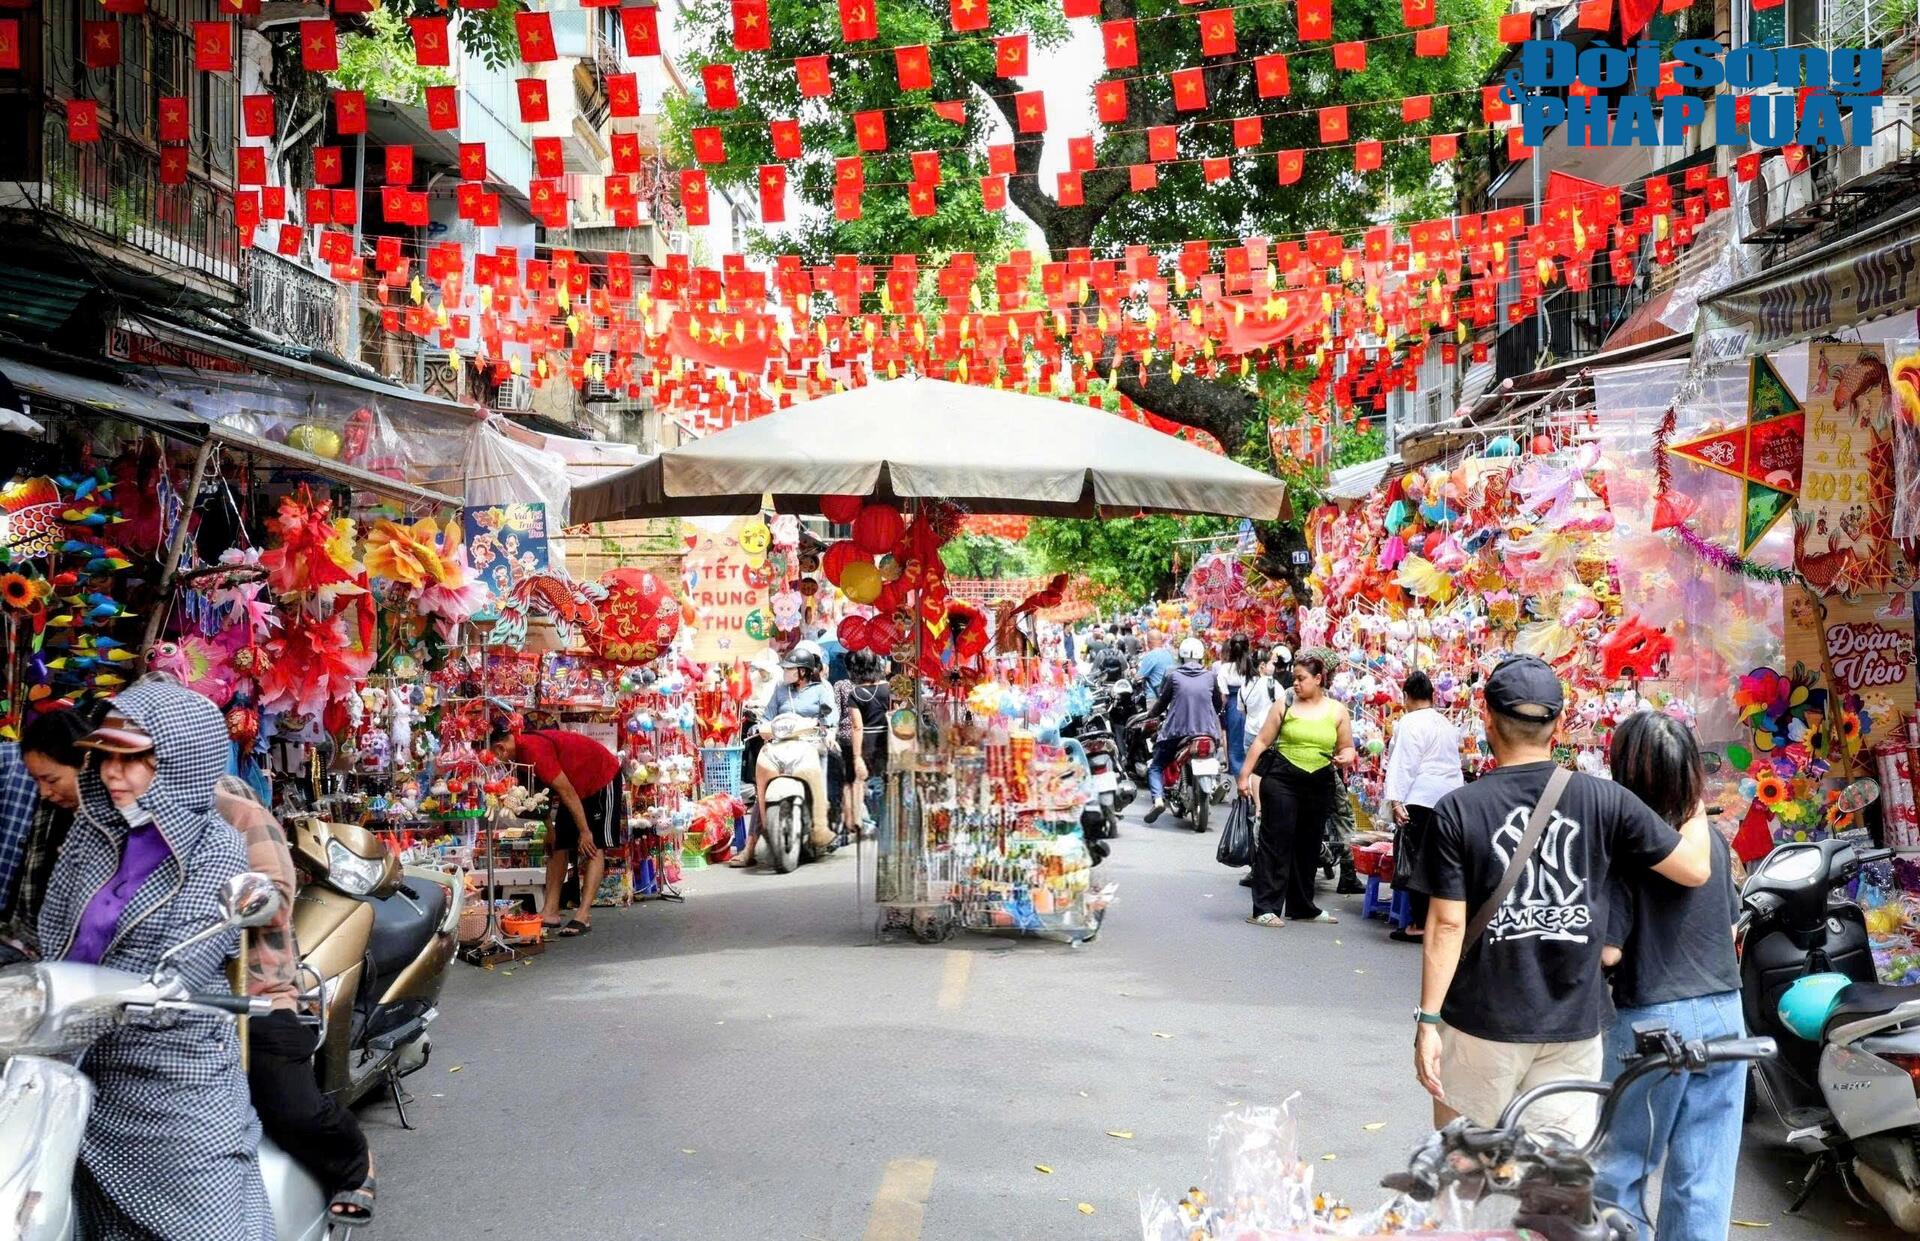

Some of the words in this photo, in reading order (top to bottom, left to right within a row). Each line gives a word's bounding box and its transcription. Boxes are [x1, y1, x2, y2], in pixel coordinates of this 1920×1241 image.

[113, 329, 129, 354] 24
[702, 556, 740, 579] TẾT
[1294, 553, 1306, 563] 19
[702, 616, 743, 630] THU
[604, 641, 658, 661] 2025
[1827, 623, 1898, 657] Đoàn
[1833, 651, 1904, 689] Viên
[1486, 904, 1591, 936] YANKEES
